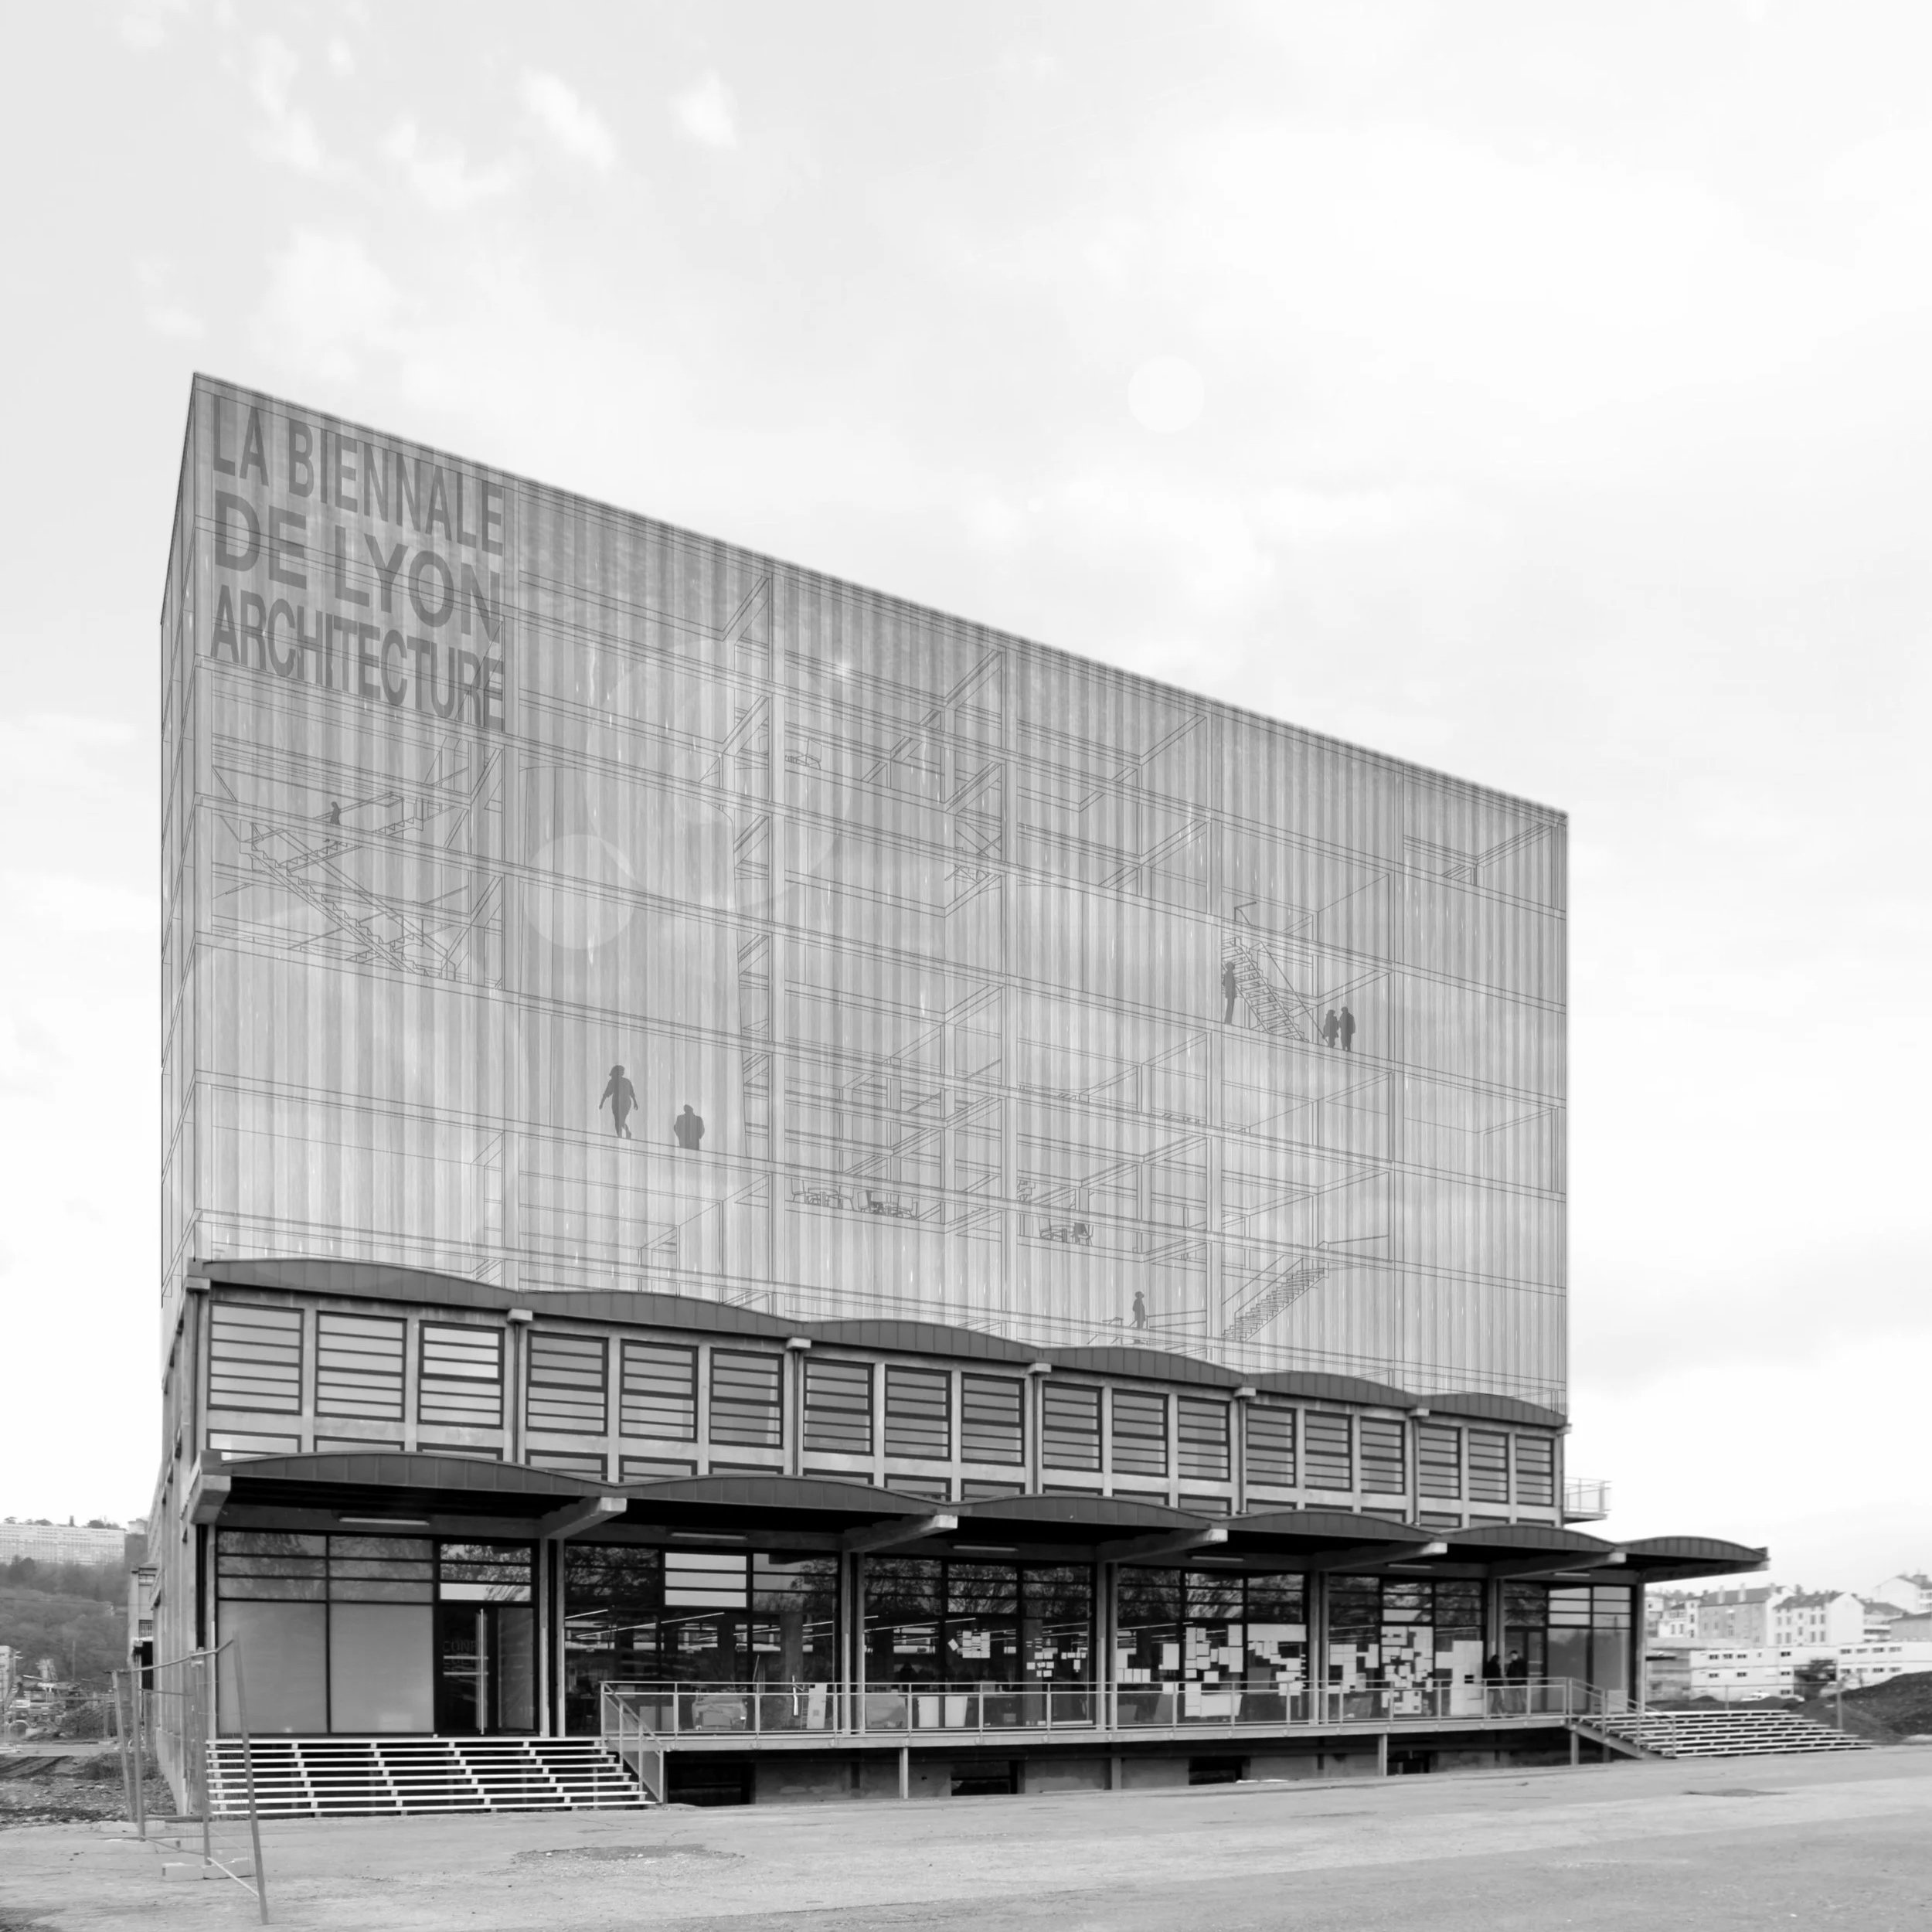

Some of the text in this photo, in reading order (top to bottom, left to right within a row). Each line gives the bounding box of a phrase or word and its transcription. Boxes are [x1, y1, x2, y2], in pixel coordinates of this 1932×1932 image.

[213, 393, 504, 557] LA BIENNALE
[215, 489, 501, 644] DE LYON
[210, 584, 505, 732] ARCHITECTURE
